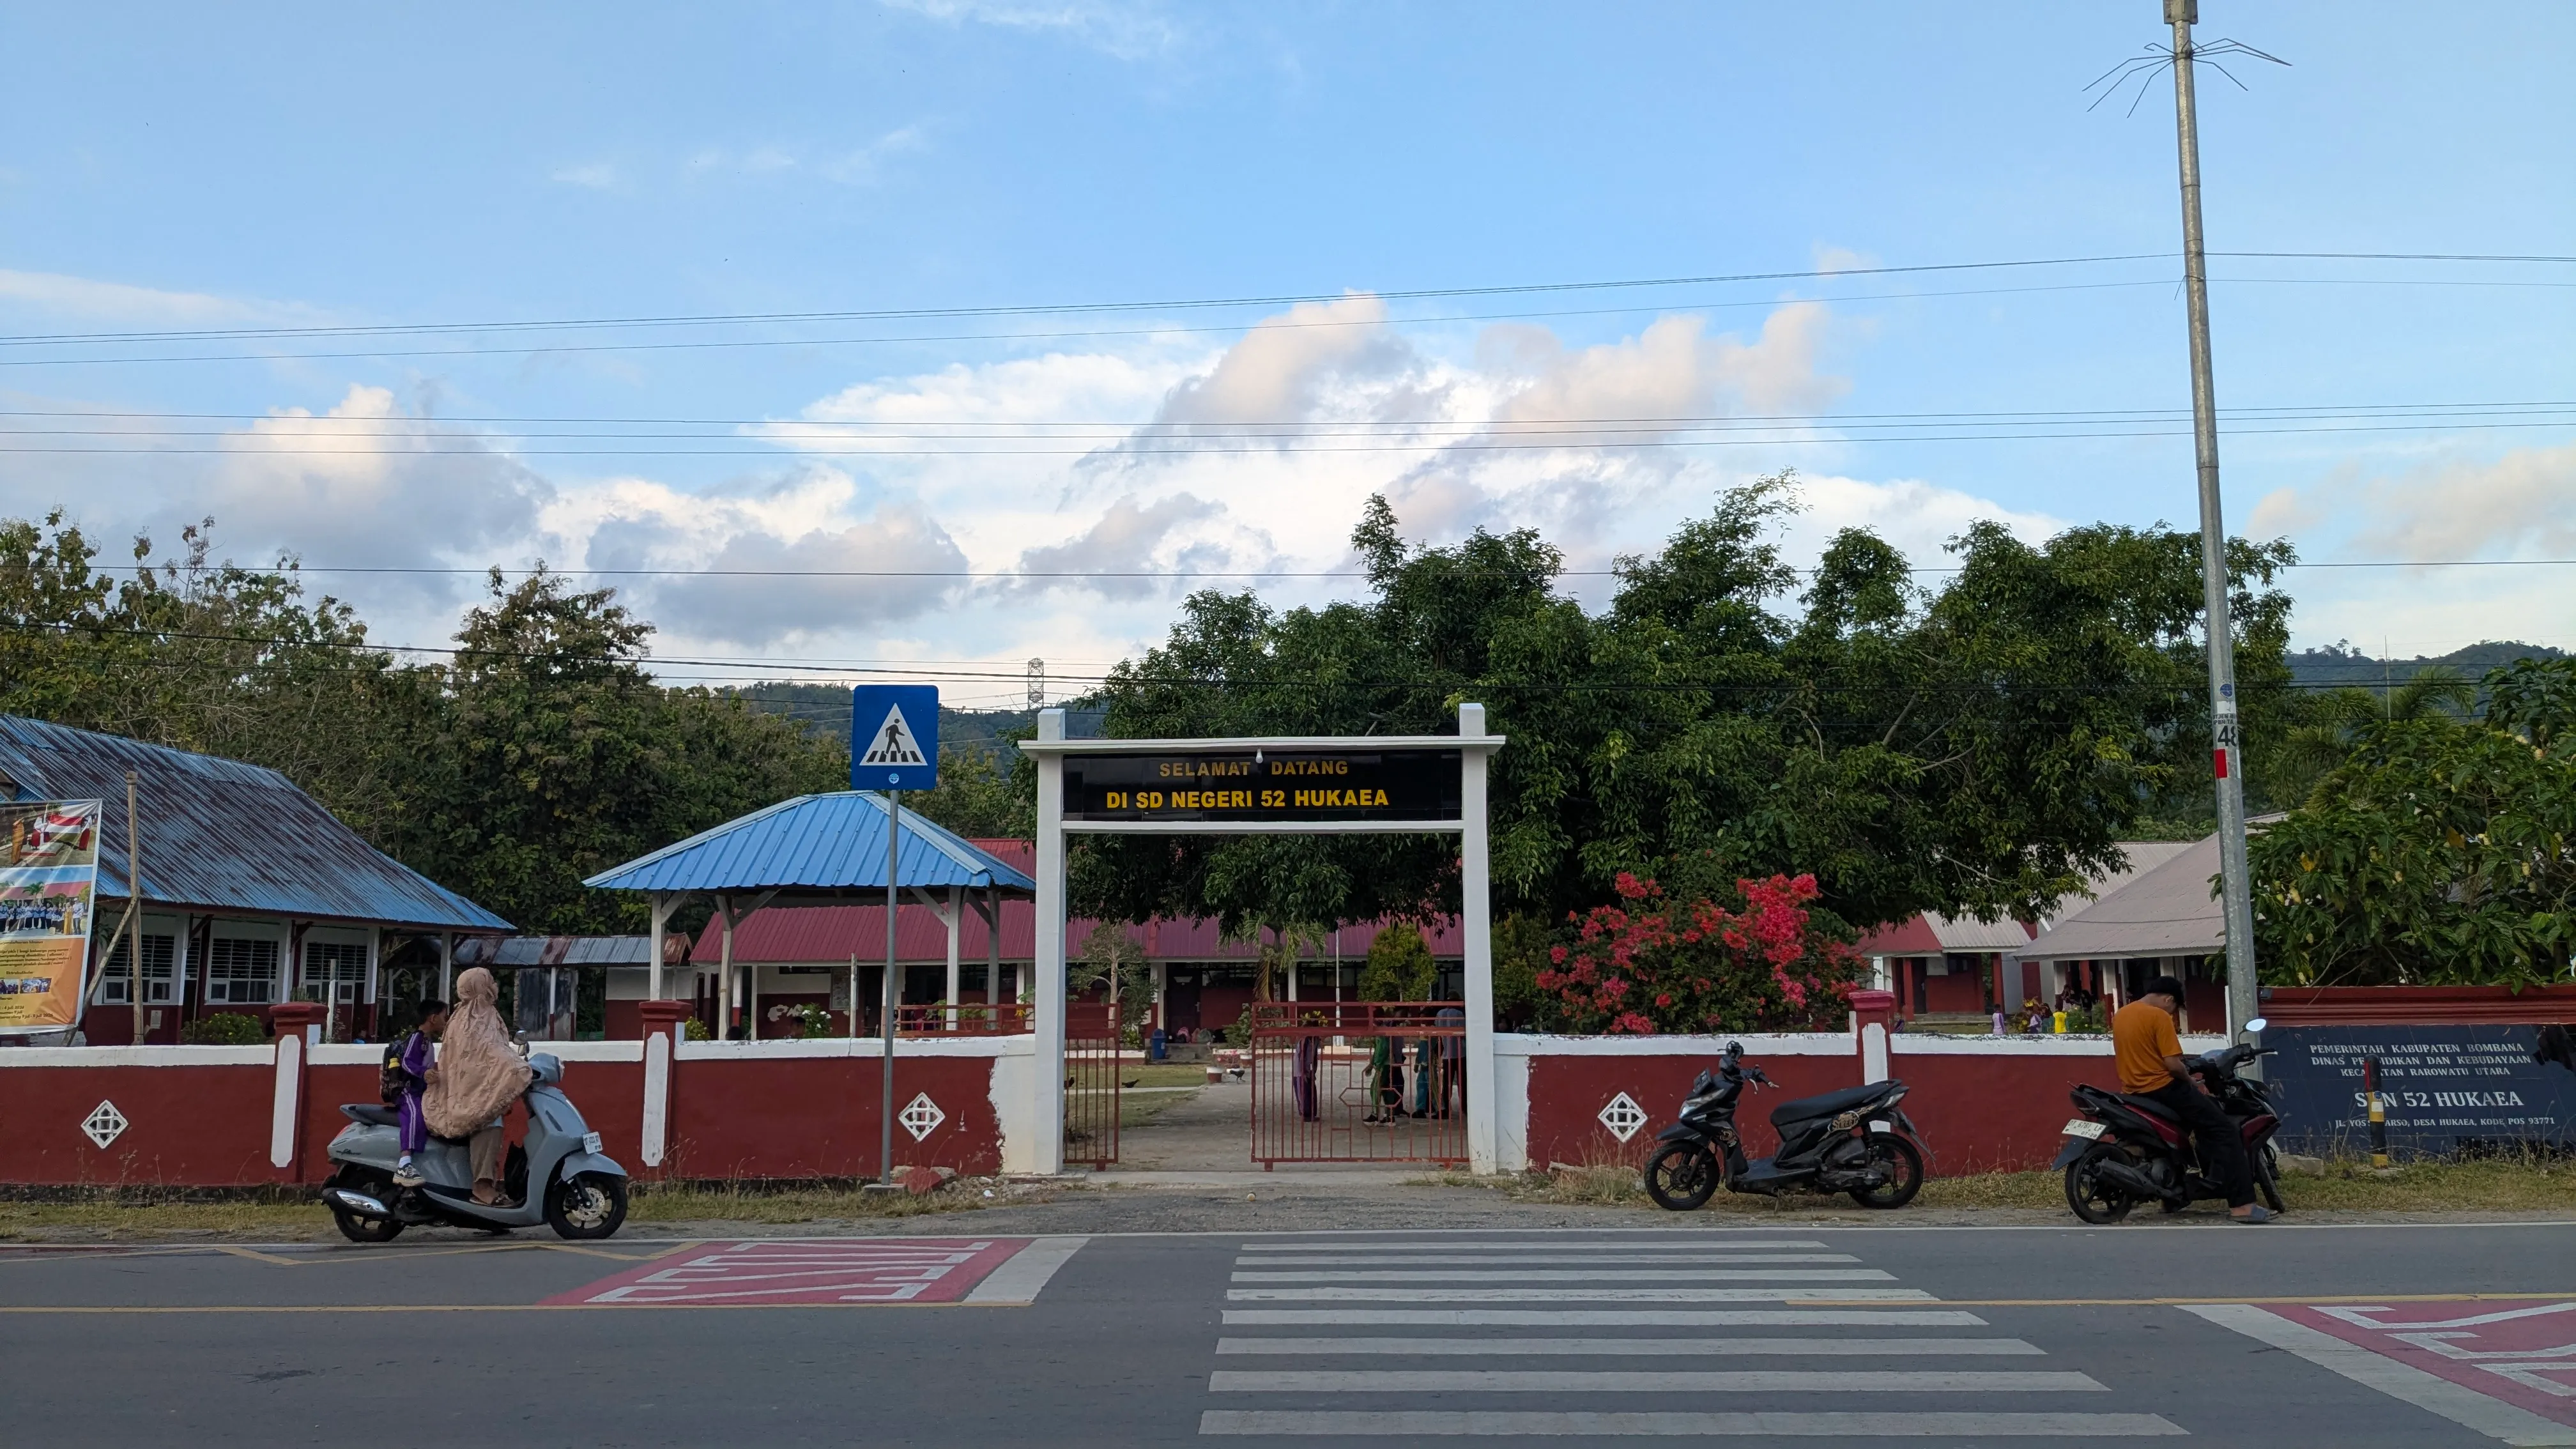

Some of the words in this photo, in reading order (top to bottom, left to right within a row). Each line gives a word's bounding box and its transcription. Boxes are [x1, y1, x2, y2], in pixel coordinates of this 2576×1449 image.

[1160, 762, 1250, 777] SELAMAT
[1271, 761, 1348, 775] DATANG
[1107, 792, 1128, 808] DI
[1136, 792, 1163, 808] SD
[1172, 791, 1252, 808] NEGERI
[1261, 790, 1285, 806] 52
[1295, 790, 1389, 806] HUKAEA
[2310, 1045, 2385, 1054] PEMERINTAH
[2391, 1044, 2460, 1054] KABUPATEN
[2467, 1043, 2525, 1052] BOMBANA
[2311, 1057, 2345, 1066] DINAS
[2351, 1056, 2420, 1065] PEIDIKAN
[2426, 1056, 2451, 1065] DAN
[2457, 1055, 2531, 1064] KEBUDAYAAN
[2341, 1068, 2404, 1077] KECATAN
[2410, 1068, 2469, 1076] RAROWATU
[2474, 1067, 2511, 1075] UTARA
[2355, 1092, 2397, 1107] SN
[2405, 1092, 2430, 1107] 52
[2436, 1091, 2524, 1107] HUKAEA
[2439, 1118, 2477, 1127] HUKAEA,
[2480, 1118, 2506, 1126] KODE
